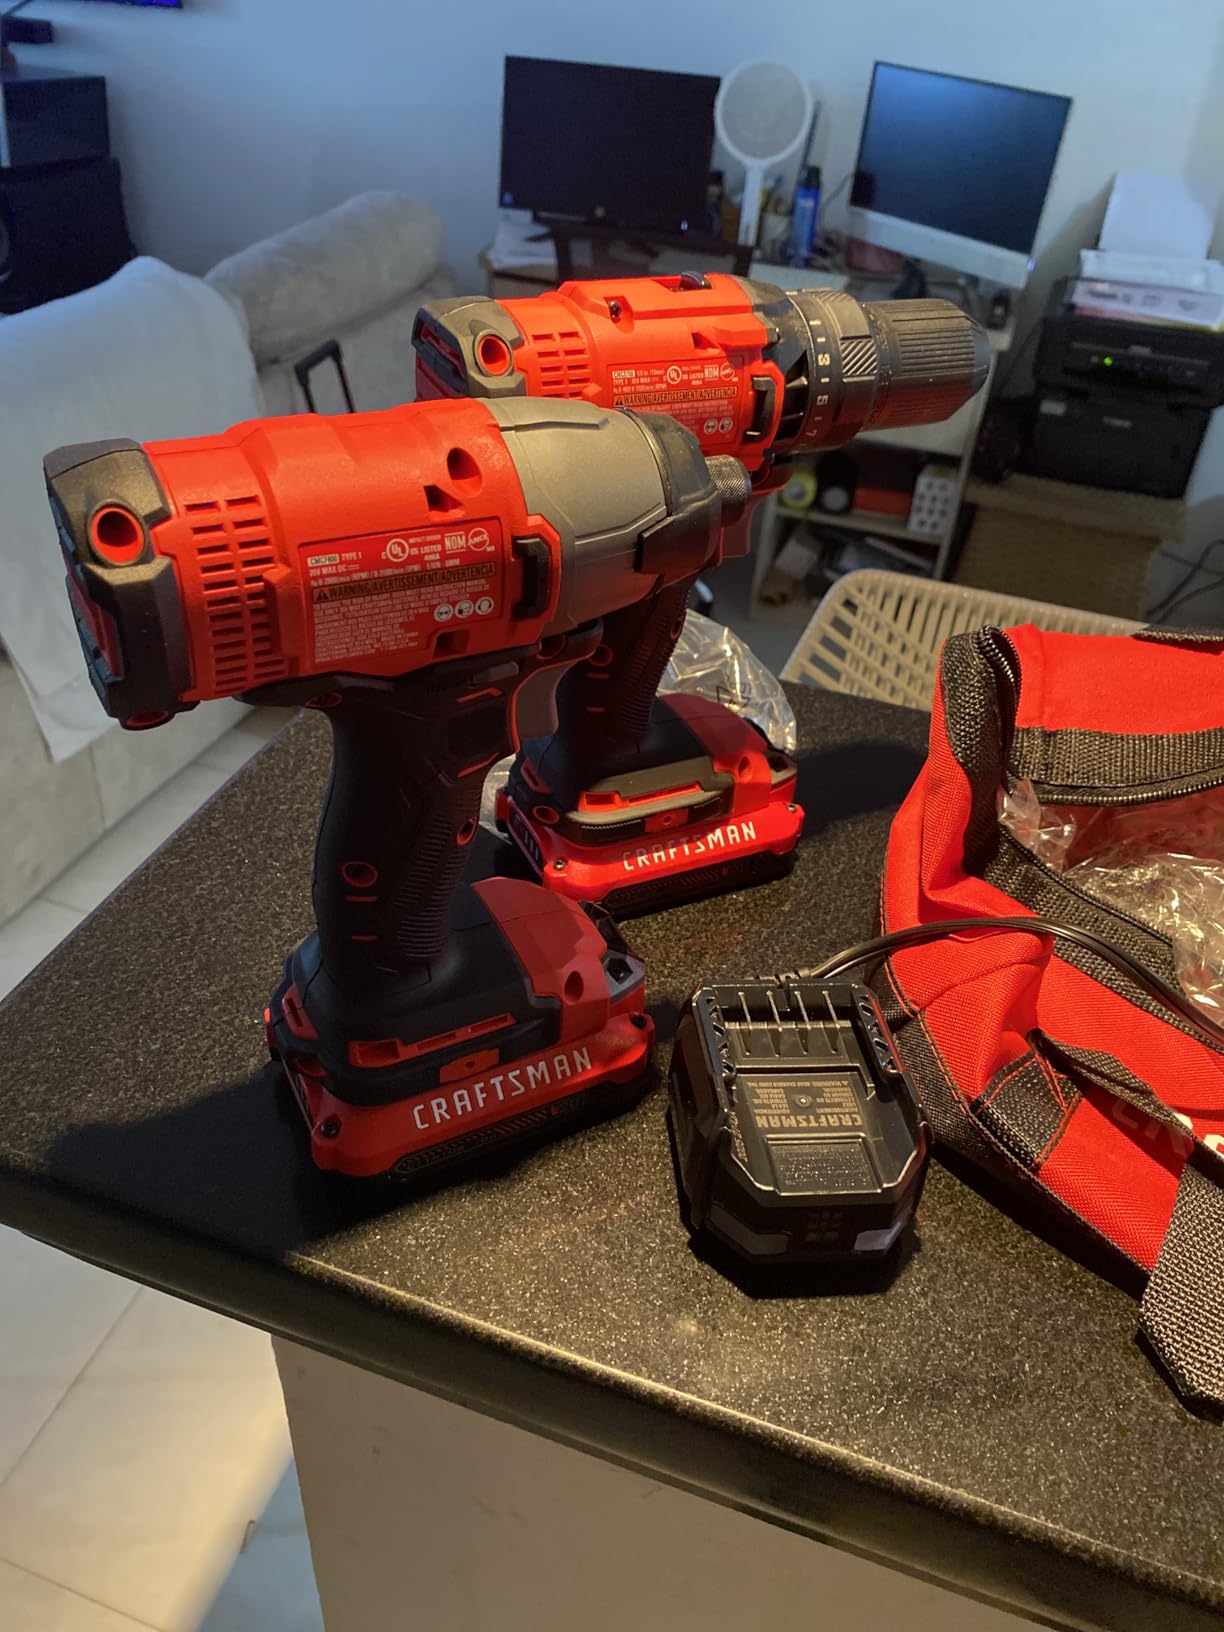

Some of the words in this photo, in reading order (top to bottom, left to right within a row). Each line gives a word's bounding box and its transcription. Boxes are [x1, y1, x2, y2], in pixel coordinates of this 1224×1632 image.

[818, 353, 830, 366] 3
[817, 395, 829, 406] 5
[420, 544, 442, 554] LISTED
[444, 535, 466, 550] NOM
[341, 552, 358, 561] TYPE
[322, 566, 337, 575] MAX
[623, 821, 757, 871] CRAFTSMAN
[413, 1047, 593, 1129] CRAFTSMAN
[755, 1115, 863, 1128] CRAFTSMAN
